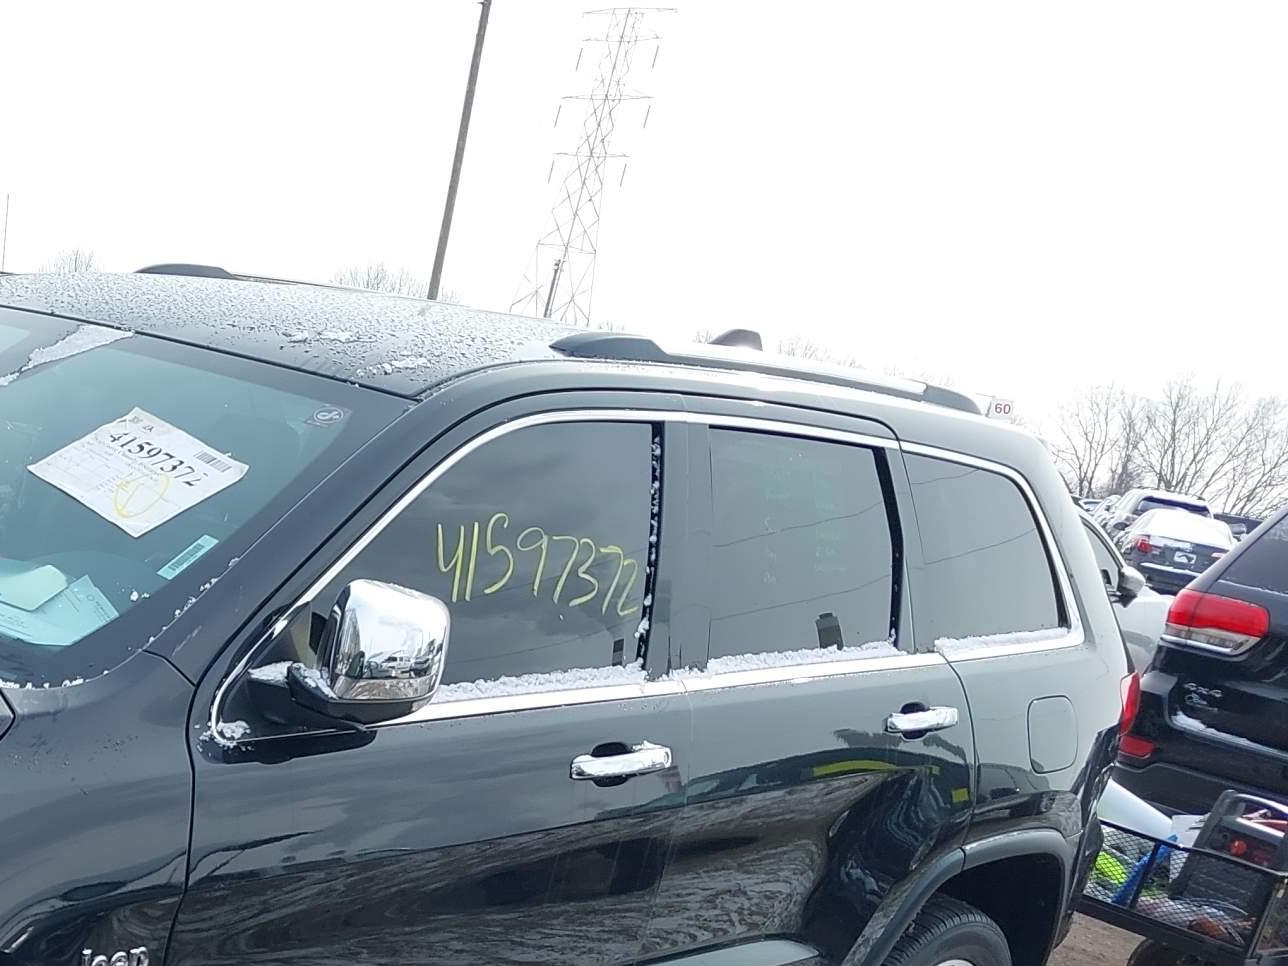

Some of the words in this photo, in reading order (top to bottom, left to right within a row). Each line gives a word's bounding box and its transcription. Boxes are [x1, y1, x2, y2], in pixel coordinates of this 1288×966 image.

[994, 402, 1011, 415] 60
[109, 432, 209, 487] 41597372
[436, 512, 640, 617] 41597372
